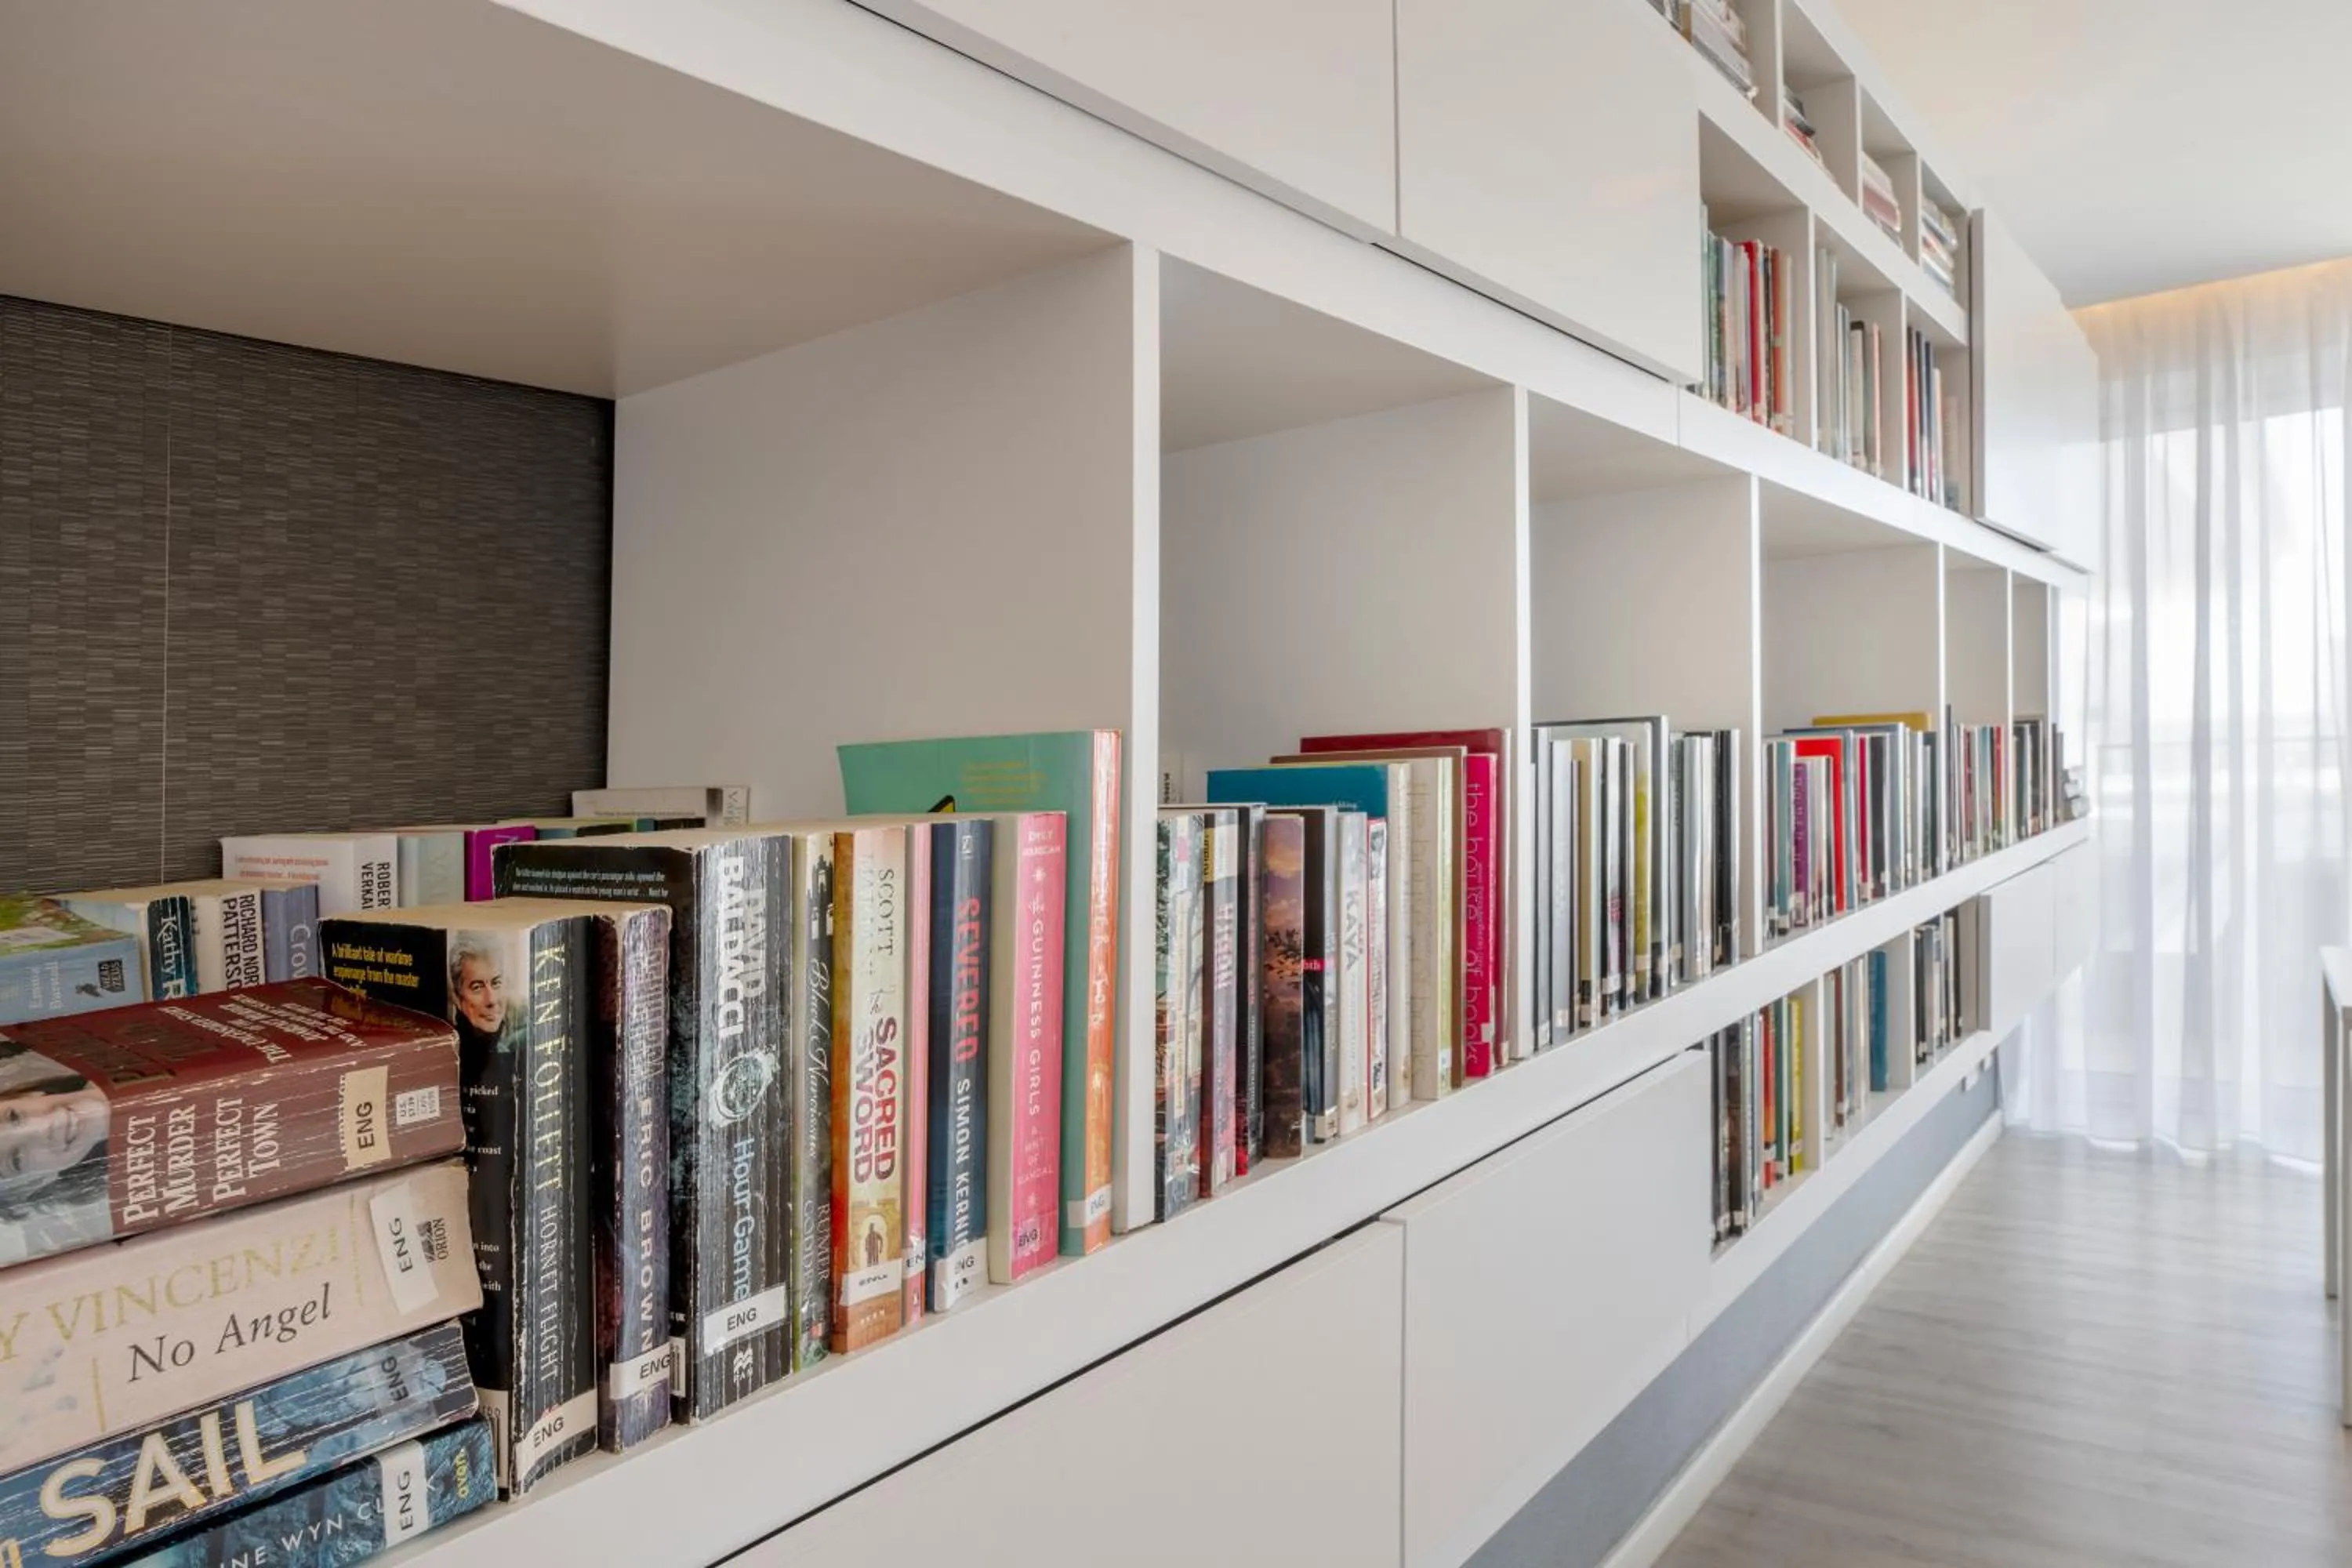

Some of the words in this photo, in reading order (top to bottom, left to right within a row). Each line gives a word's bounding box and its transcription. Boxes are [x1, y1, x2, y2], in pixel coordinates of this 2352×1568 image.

[239, 893, 257, 953] RICHARD
[377, 862, 390, 909] ROBER
[878, 868, 894, 956] SCOTT
[158, 915, 184, 978] Kathy
[534, 943, 566, 1025] KEN
[719, 856, 744, 1036] BALDACCI
[744, 889, 767, 998] DAVID
[956, 898, 980, 1062] SEVERED
[1029, 919, 1044, 1039] GUINNESS
[808, 958, 830, 1036] Black
[355, 1101, 376, 1150] ENG
[534, 1036, 566, 1190] FOLLETT
[808, 1036, 830, 1159] Narcissus
[854, 1026, 875, 1184] SWORD
[875, 1017, 897, 1181] SACRED
[955, 1077, 971, 1164] SIMON
[1029, 1049, 1042, 1116] GIRLS
[123, 1115, 158, 1225] PERFECT
[165, 1103, 199, 1217] MURDER
[212, 1097, 247, 1203] PERFECT
[248, 1102, 281, 1179] TOWN
[640, 1098, 653, 1188] ERIC
[733, 1138, 755, 1210] Hour
[389, 1218, 413, 1273] ENG
[432, 1217, 449, 1261] ORION
[539, 1205, 558, 1296] HORNET
[640, 1210, 654, 1352] BROWN
[733, 1214, 755, 1301] Game
[816, 1203, 831, 1282] RUMER
[45, 1229, 339, 1342] VINCENZI
[727, 1307, 757, 1332] ENG
[127, 1334, 195, 1383] No
[216, 1281, 331, 1355] Angel
[539, 1300, 558, 1383] FLIGHT
[640, 1352, 672, 1380] ENG
[381, 1355, 409, 1402] ENG
[533, 1416, 564, 1447] ENG
[40, 1399, 307, 1558] SAIL
[398, 1470, 415, 1531] ENG
[281, 1512, 343, 1552] WYN
